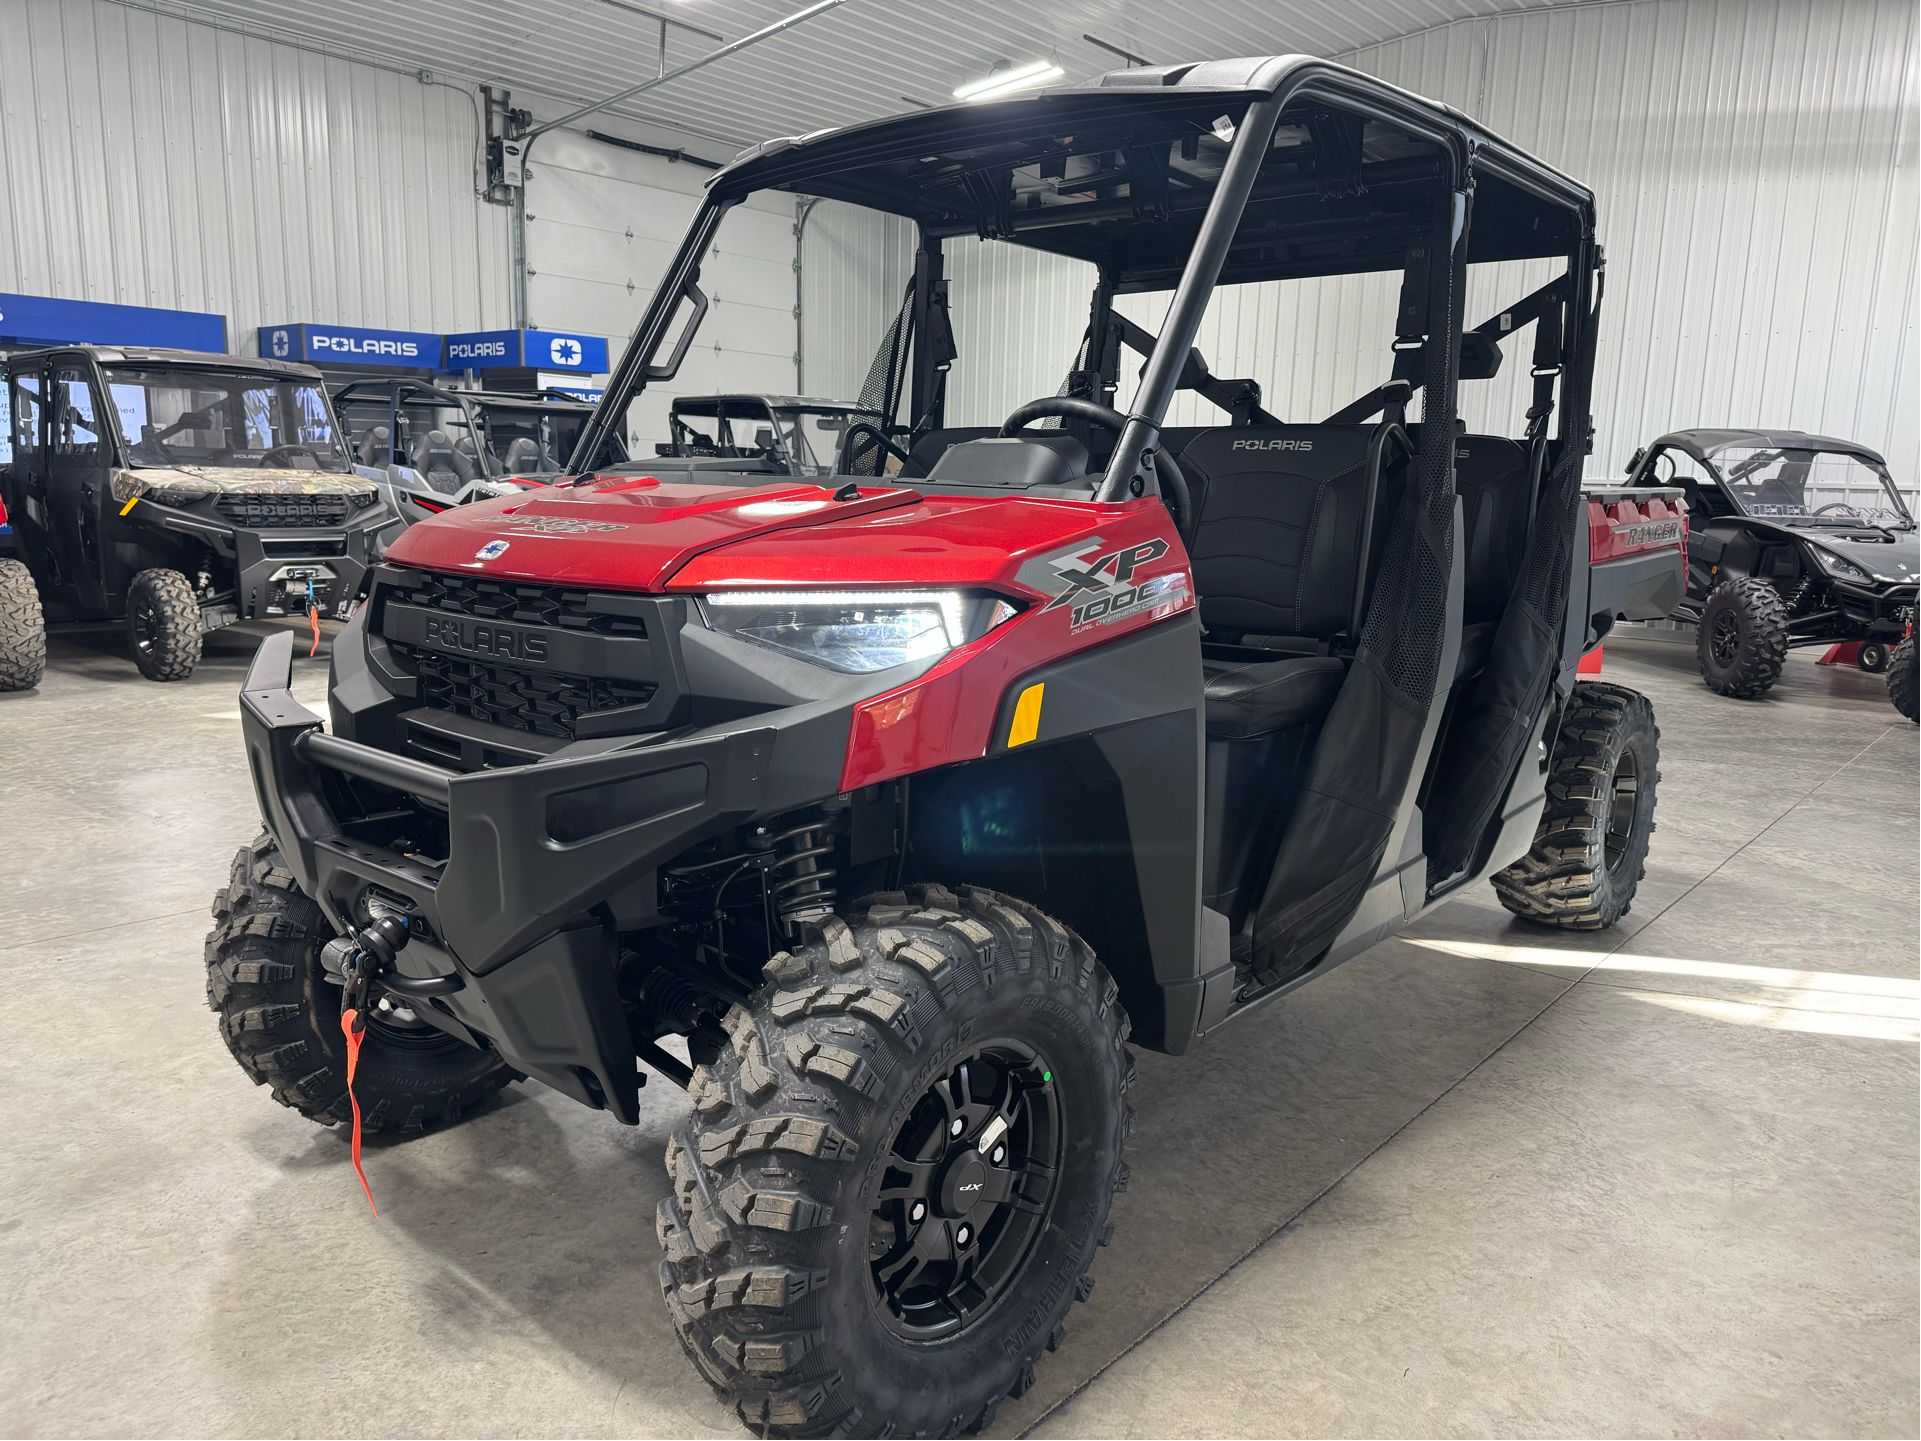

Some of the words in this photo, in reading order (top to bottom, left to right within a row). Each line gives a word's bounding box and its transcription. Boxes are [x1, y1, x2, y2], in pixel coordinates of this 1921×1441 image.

[313, 335, 418, 357] POLARIS
[450, 341, 505, 359] POLARIS
[1232, 440, 1313, 451] POLARIS
[246, 504, 329, 516] POLARIS
[1624, 520, 1679, 548] RANGER
[1037, 537, 1170, 616] XP
[1069, 578, 1164, 630] 1000
[1071, 624, 1094, 636] DUAL
[1095, 605, 1141, 626] OVERHEAD
[425, 616, 548, 664] POLARIS
[959, 1183, 983, 1192] XP
